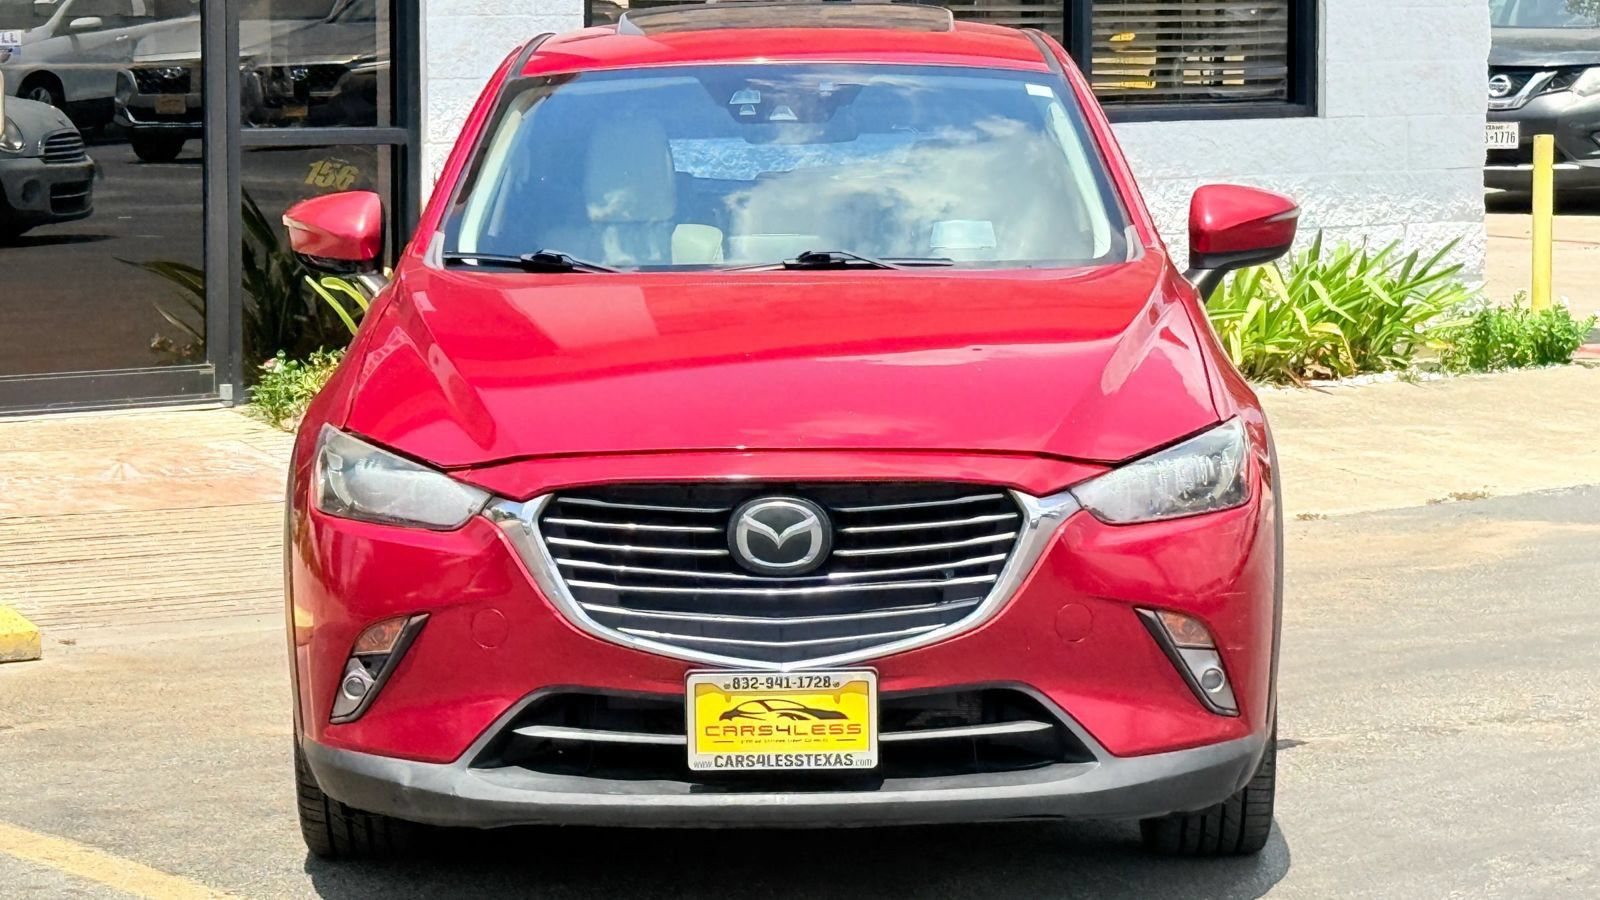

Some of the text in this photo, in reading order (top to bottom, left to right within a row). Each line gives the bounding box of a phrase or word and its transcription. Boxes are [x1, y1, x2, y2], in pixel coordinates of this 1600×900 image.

[304, 159, 359, 190] 156
[732, 676, 832, 690] 832-941-1728
[705, 723, 862, 737] CARS4LESS
